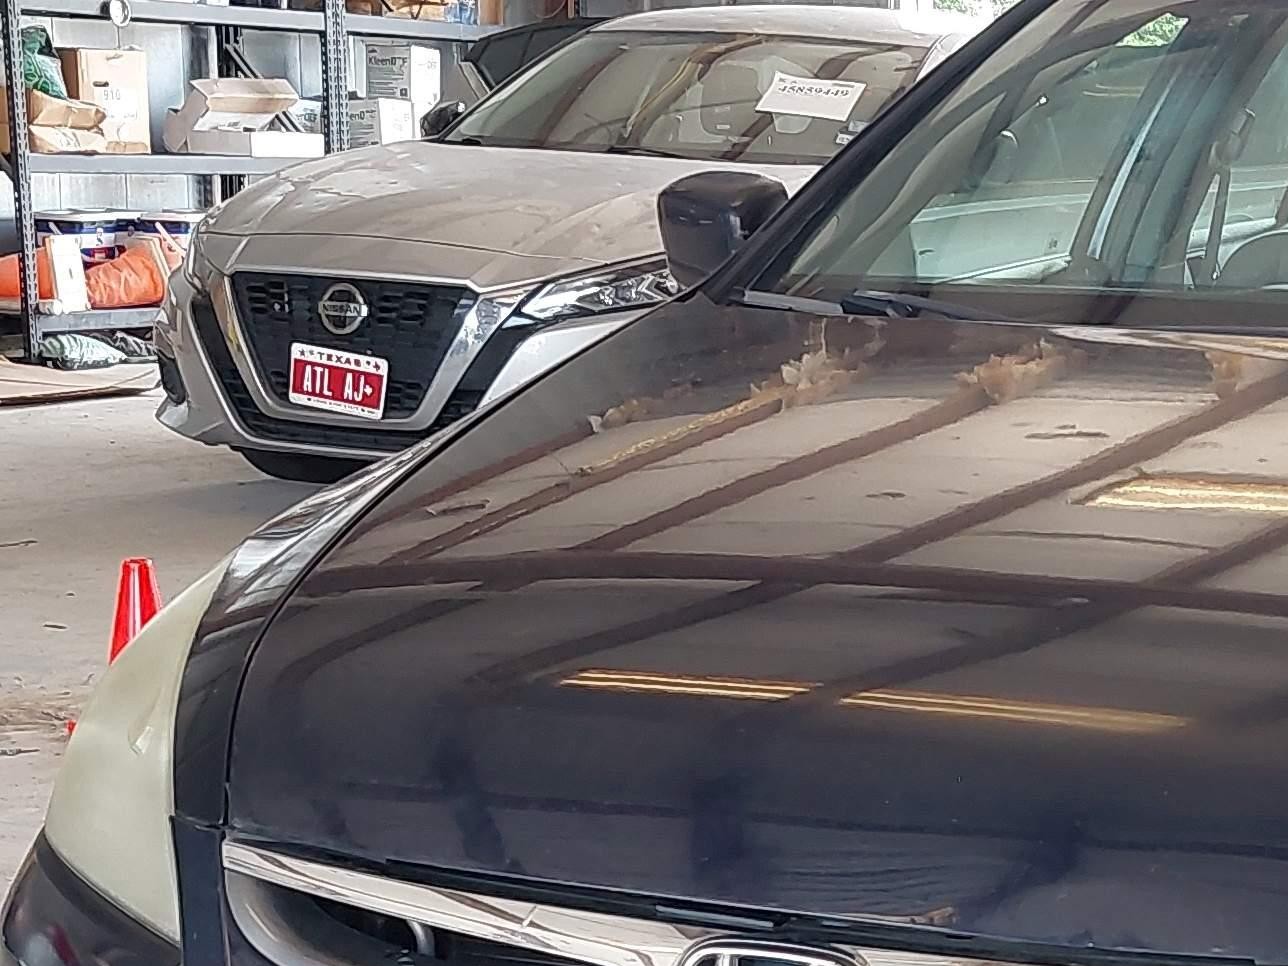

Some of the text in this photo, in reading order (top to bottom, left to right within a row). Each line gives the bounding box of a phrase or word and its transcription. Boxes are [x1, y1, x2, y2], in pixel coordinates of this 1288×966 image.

[322, 303, 361, 315] NISSAN
[317, 351, 362, 367] TEXAS
[303, 364, 365, 402] ATL AJ
